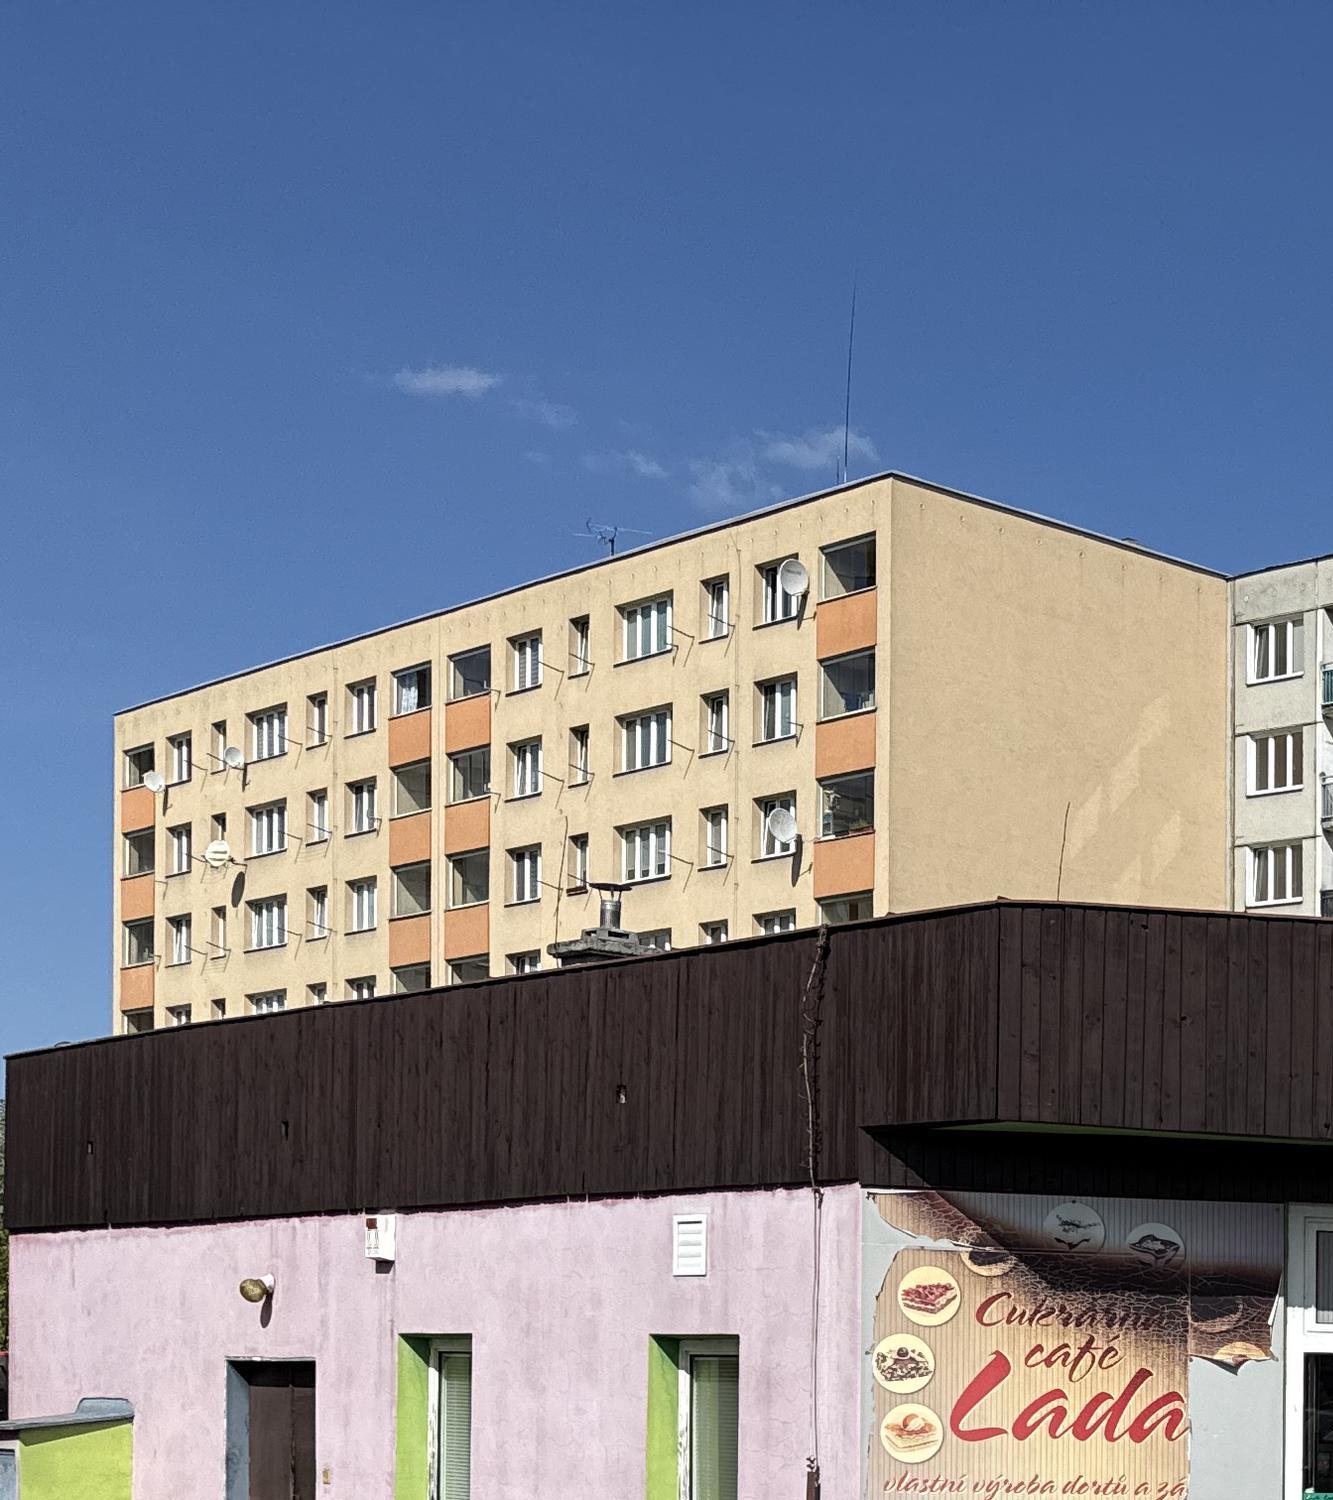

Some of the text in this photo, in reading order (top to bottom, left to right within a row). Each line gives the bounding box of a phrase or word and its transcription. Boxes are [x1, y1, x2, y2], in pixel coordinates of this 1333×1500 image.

[975, 1291, 1166, 1330] Cukrárna
[1024, 1334, 1127, 1383] café
[950, 1349, 1190, 1444] Lada
[883, 1470, 967, 1496] vlastní
[1061, 1474, 1129, 1496] dortů
[1134, 1480, 1152, 1496] a
